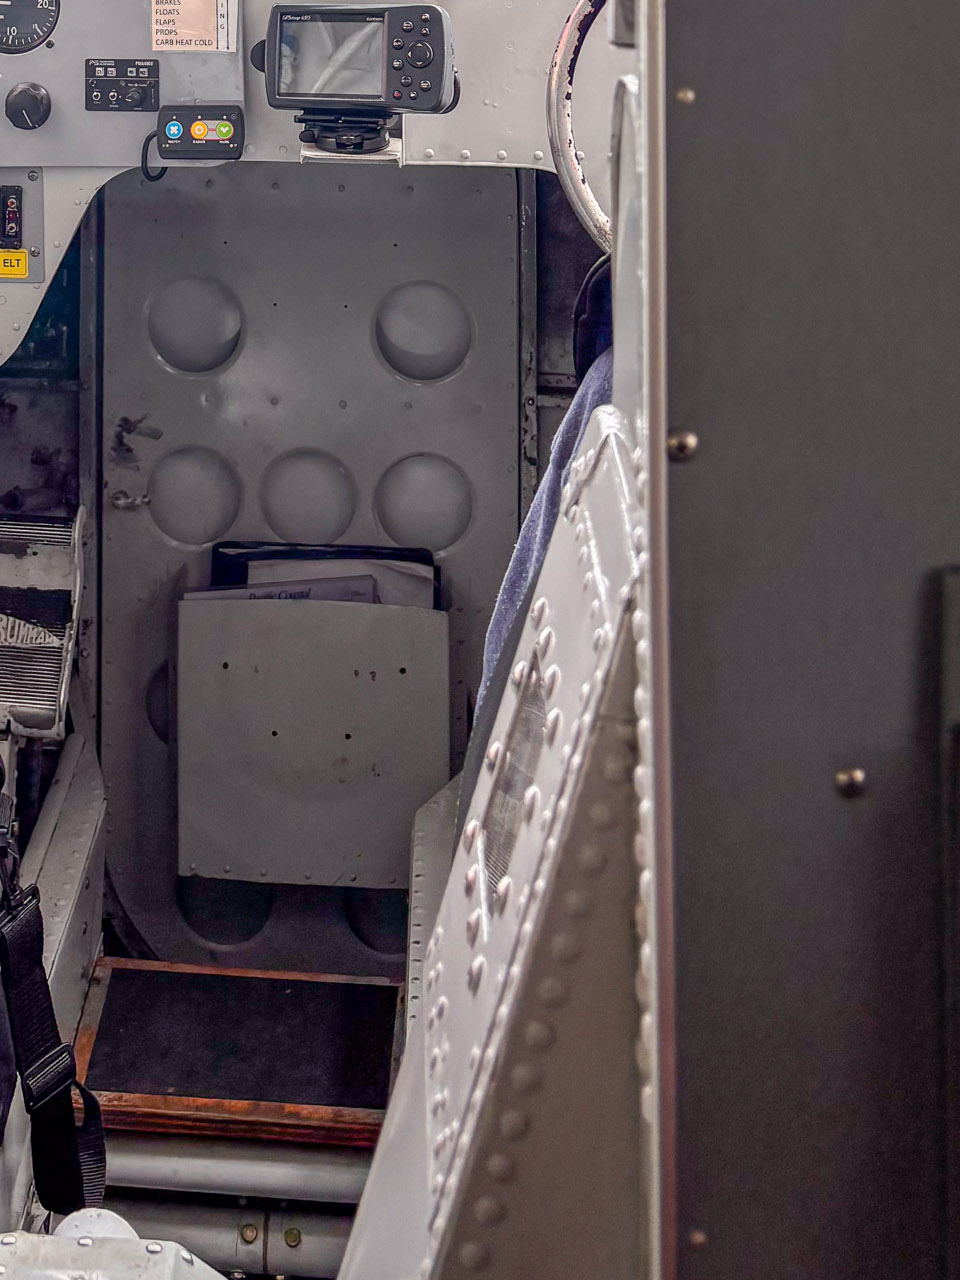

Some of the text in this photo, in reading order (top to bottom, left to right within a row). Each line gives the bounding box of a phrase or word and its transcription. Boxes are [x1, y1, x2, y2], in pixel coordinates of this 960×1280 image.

[37, 0, 49, 8] 20
[7, 27, 17, 36] 10
[3, 259, 21, 267] ELT
